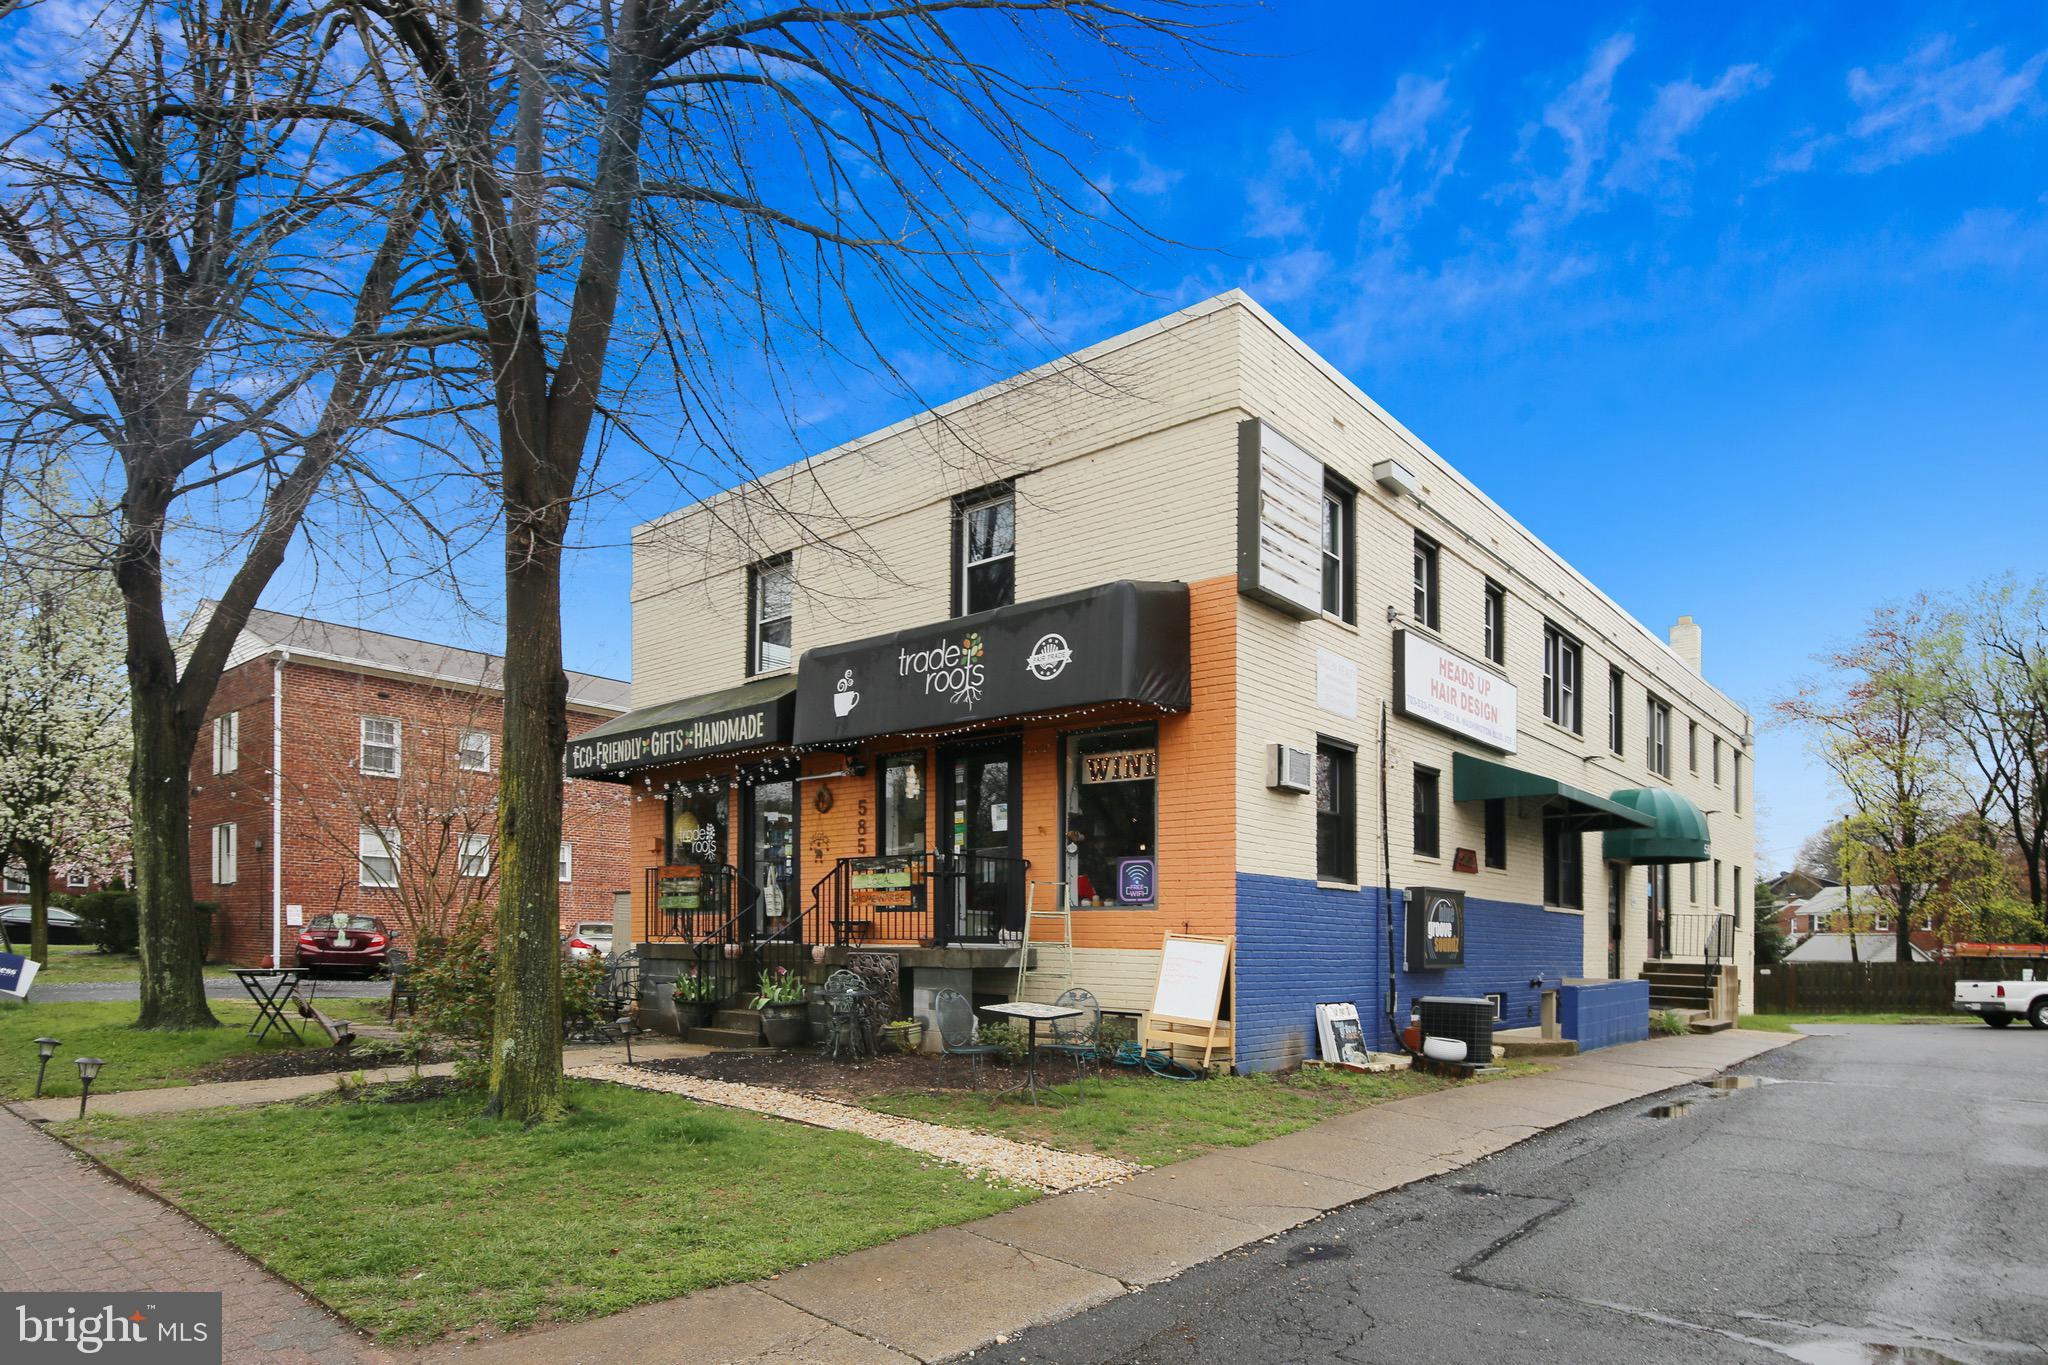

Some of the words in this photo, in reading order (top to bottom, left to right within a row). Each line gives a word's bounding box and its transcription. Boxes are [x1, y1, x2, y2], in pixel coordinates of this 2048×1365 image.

[899, 638, 961, 676] trade
[925, 659, 985, 696] roots
[1439, 657, 1475, 690] HEADS
[1477, 677, 1491, 697] UP
[1430, 677, 1458, 708] HAIR
[1460, 691, 1499, 724] DESIGN
[651, 729, 684, 757] GIFTS
[694, 712, 765, 749] HANDMADE
[692, 840, 717, 855] roots
[1427, 921, 1453, 940] groove
